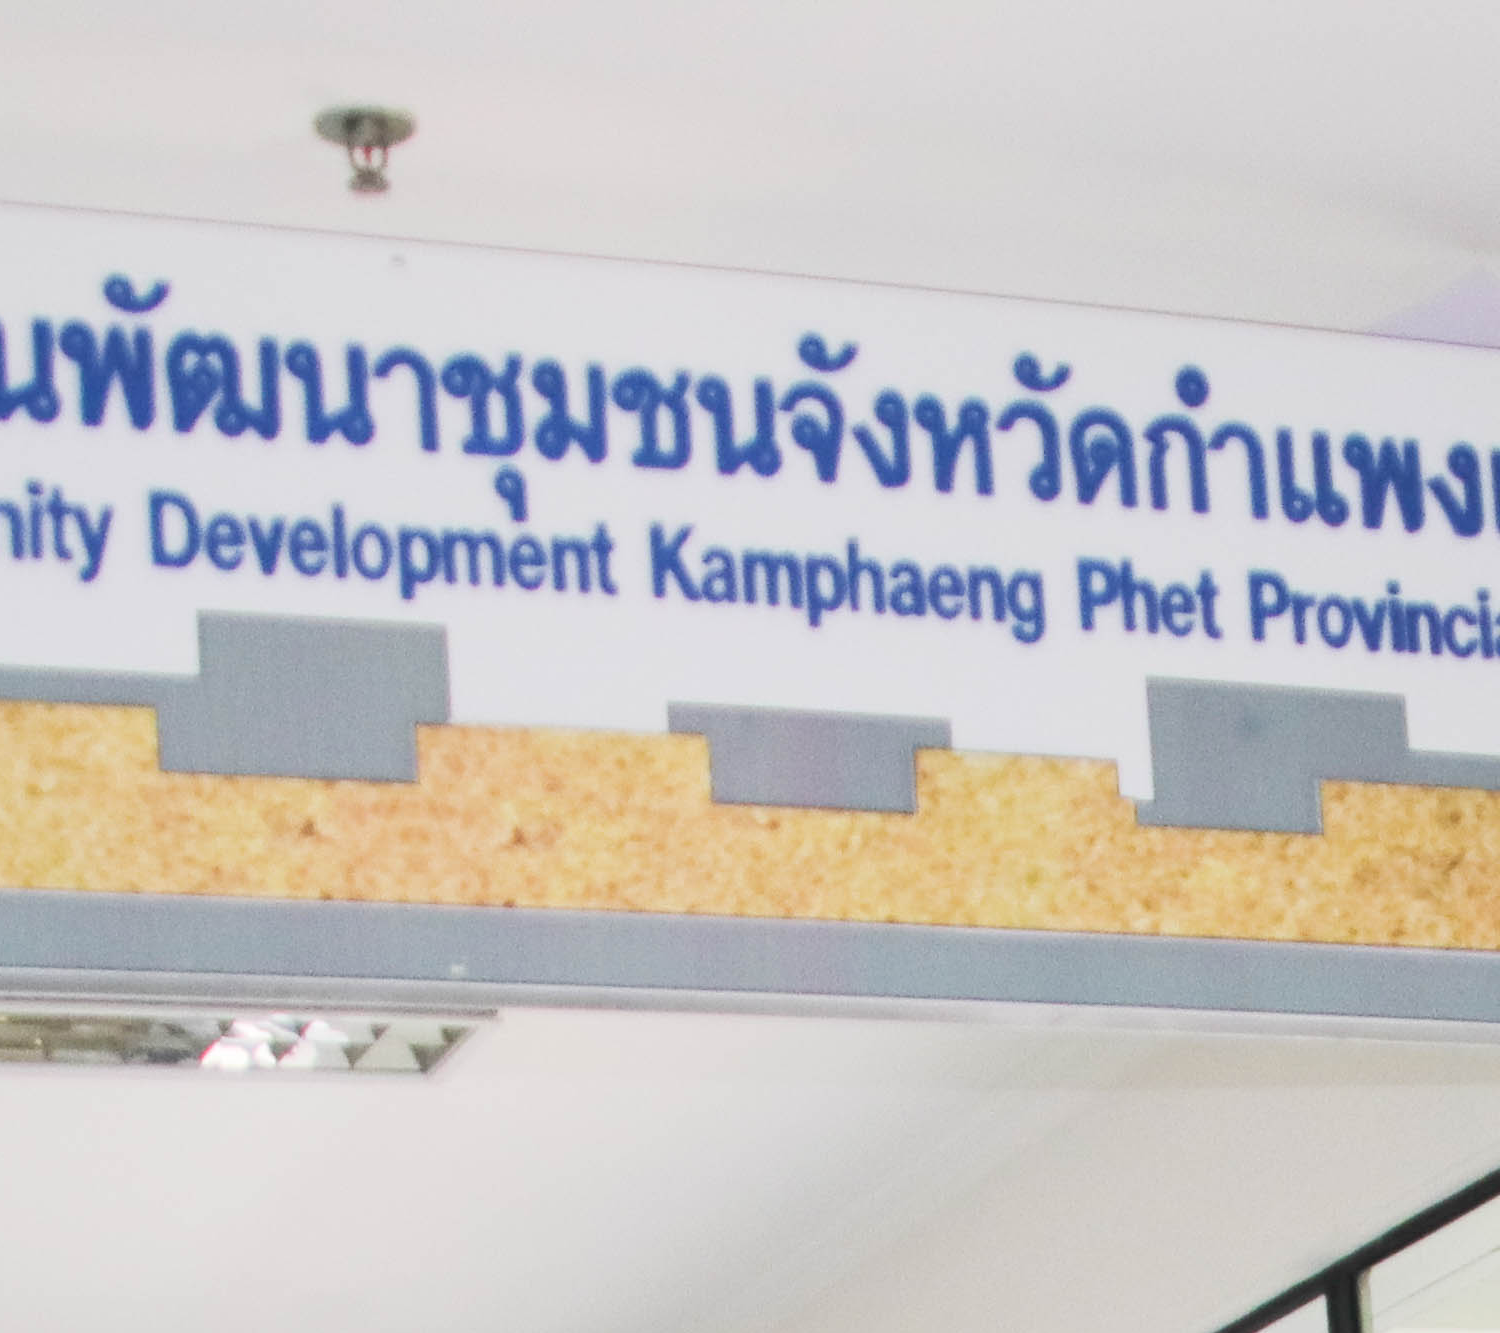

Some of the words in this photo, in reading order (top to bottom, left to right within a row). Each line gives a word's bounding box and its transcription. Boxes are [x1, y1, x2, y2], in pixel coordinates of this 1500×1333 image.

[147, 490, 617, 600] Development
[649, 524, 1045, 644] Kamphaeng
[1076, 557, 1221, 639] Phet
